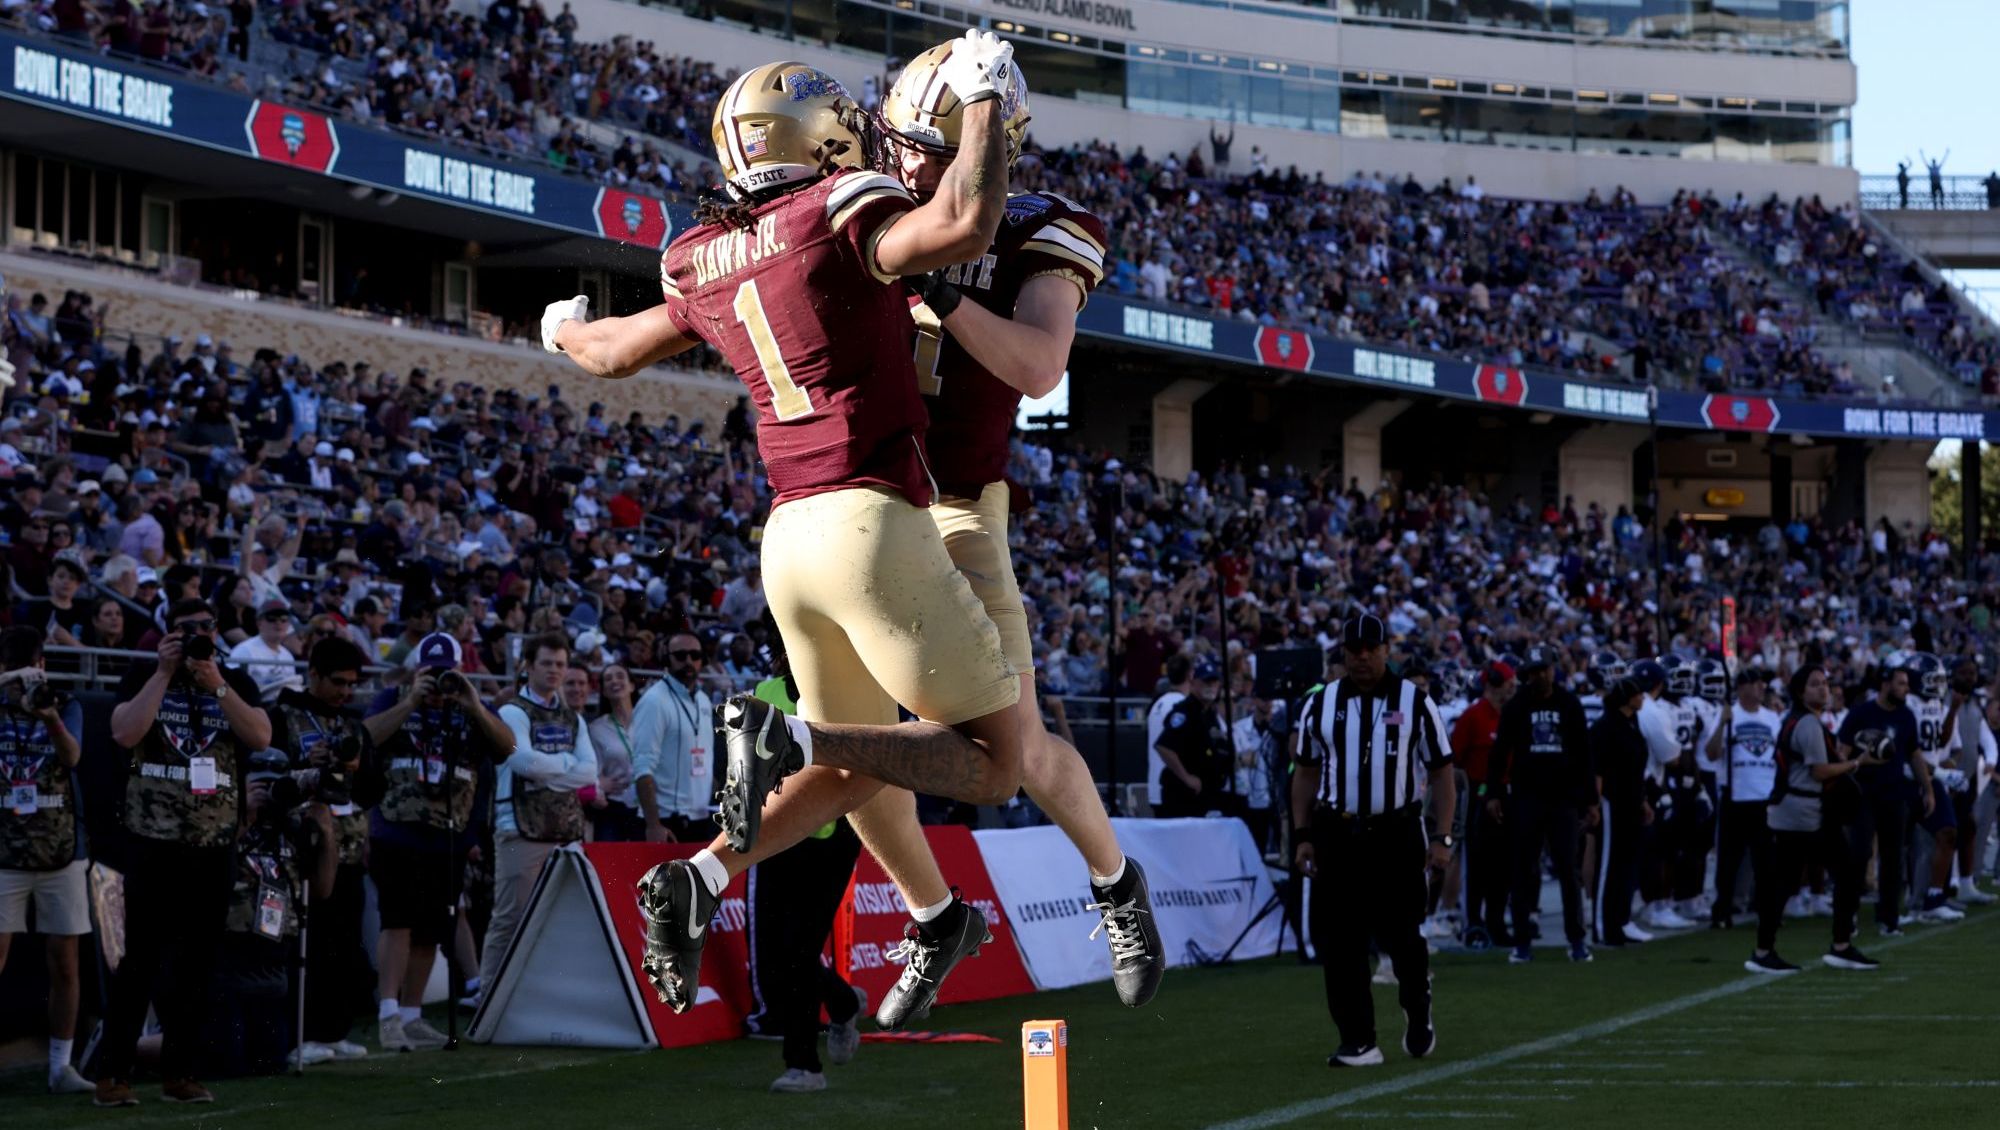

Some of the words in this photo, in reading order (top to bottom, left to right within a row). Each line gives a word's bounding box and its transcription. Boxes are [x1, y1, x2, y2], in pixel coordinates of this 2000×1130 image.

[1044, 0, 1093, 21] ALAMO
[1095, 4, 1137, 31] BOWL
[14, 45, 58, 99] BOWL
[60, 58, 91, 107] FOR
[93, 66, 122, 115] THE
[123, 75, 173, 128] BRAVE
[908, 122, 937, 139] BOBCATS
[404, 147, 443, 193] BOWL
[444, 157, 469, 199] FOR
[470, 163, 494, 205] THE
[494, 169, 535, 214] BRAVE
[749, 168, 788, 186] STATE
[692, 227, 749, 287] DAWN
[751, 213, 786, 263] JR.
[943, 254, 998, 290] ATE
[1123, 305, 1149, 340] BOWL
[1150, 310, 1168, 342] FOR
[1168, 314, 1185, 345] THE
[1185, 317, 1213, 350] BRAVE
[732, 278, 815, 421] 1
[1353, 348, 1378, 378] BOWL
[1378, 352, 1393, 381] FOR
[1394, 354, 1409, 384] THE
[1410, 357, 1435, 388] BRAVE
[1563, 383, 1586, 409] BOWL
[1586, 386, 1603, 412] FOR
[1603, 388, 1619, 415] THE
[1844, 408, 1881, 433] BOWL
[1883, 409, 1910, 434] FOR
[1911, 411, 1936, 436] THE
[1938, 412, 1984, 437] BRAVE
[201, 715, 231, 731] RCES
[1530, 709, 1561, 725] RICE
[1387, 740, 1397, 756] L
[167, 764, 186, 781] FOR
[1018, 898, 1078, 923] LOCKHEED
[1151, 889, 1203, 907] LOCKHEED
[1202, 887, 1242, 905] MARTIN
